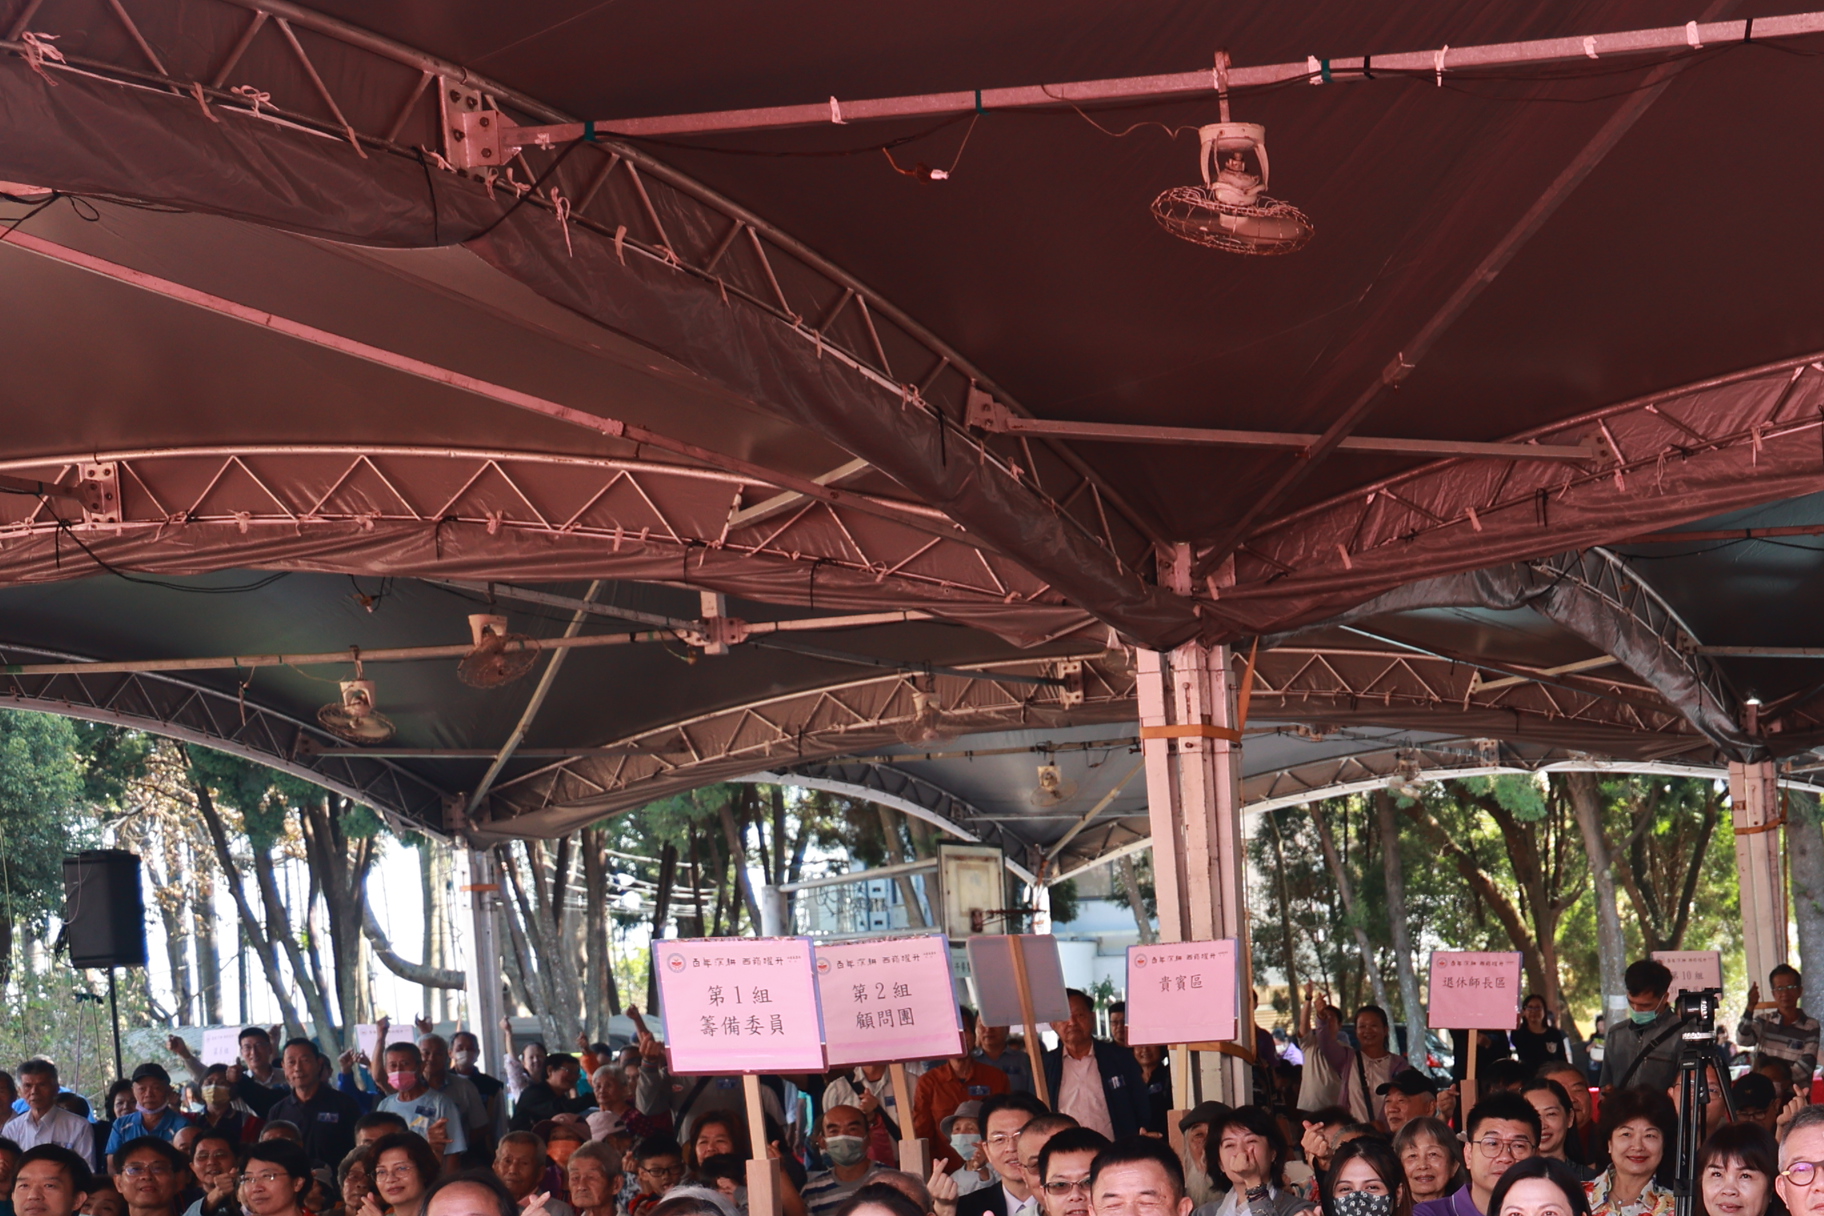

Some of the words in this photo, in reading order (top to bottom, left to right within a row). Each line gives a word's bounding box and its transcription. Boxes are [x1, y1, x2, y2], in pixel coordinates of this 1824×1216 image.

[852, 982, 912, 1003] 第2組
[1159, 974, 1203, 992] 貴賓區
[1442, 977, 1506, 989] 退休師長區
[708, 985, 772, 1007] 第1組
[700, 1014, 785, 1037] 籌備委員
[856, 1007, 915, 1030] 顧問團
